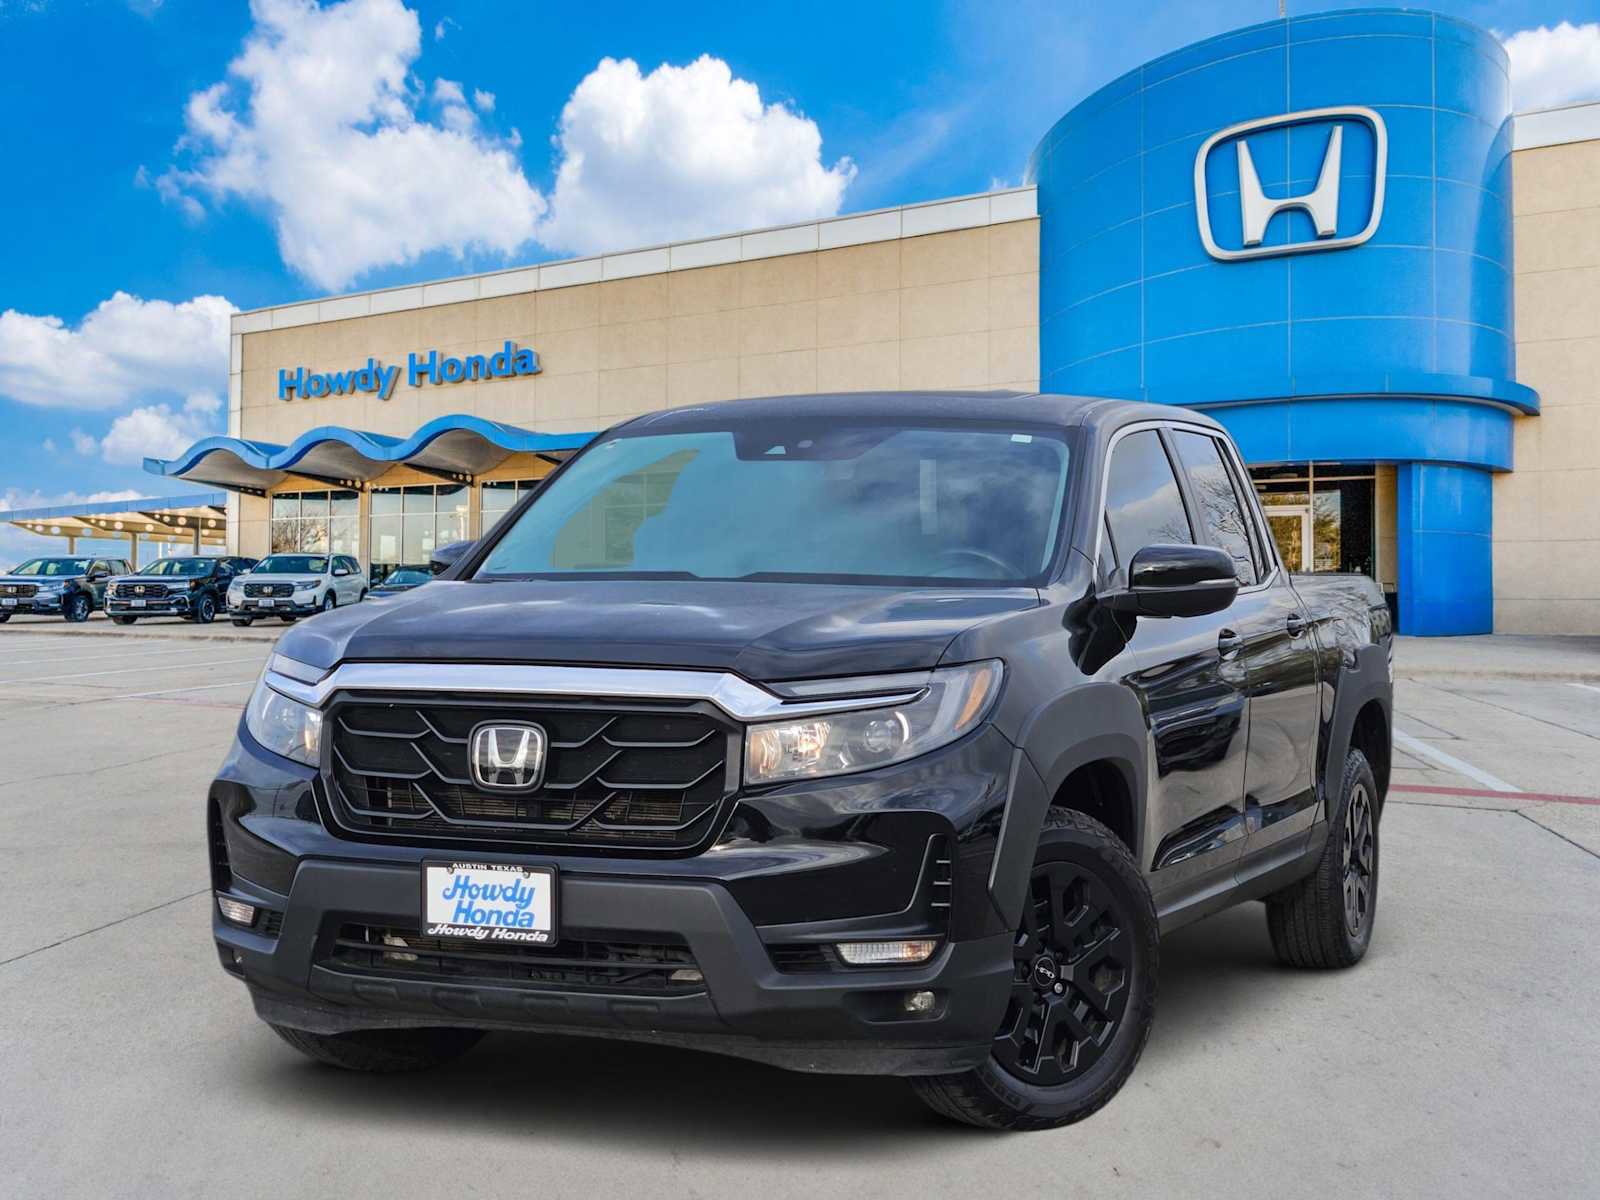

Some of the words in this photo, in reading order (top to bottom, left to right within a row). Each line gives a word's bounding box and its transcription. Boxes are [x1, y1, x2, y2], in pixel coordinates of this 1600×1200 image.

[278, 358, 401, 401] Howdy
[408, 340, 542, 388] Honda
[452, 863, 488, 871] AUSTIN
[491, 865, 524, 873] TEXAS
[442, 874, 536, 910] Howdy
[452, 900, 536, 928] Honda
[428, 923, 490, 940] Howdy
[491, 928, 549, 942] Honda
